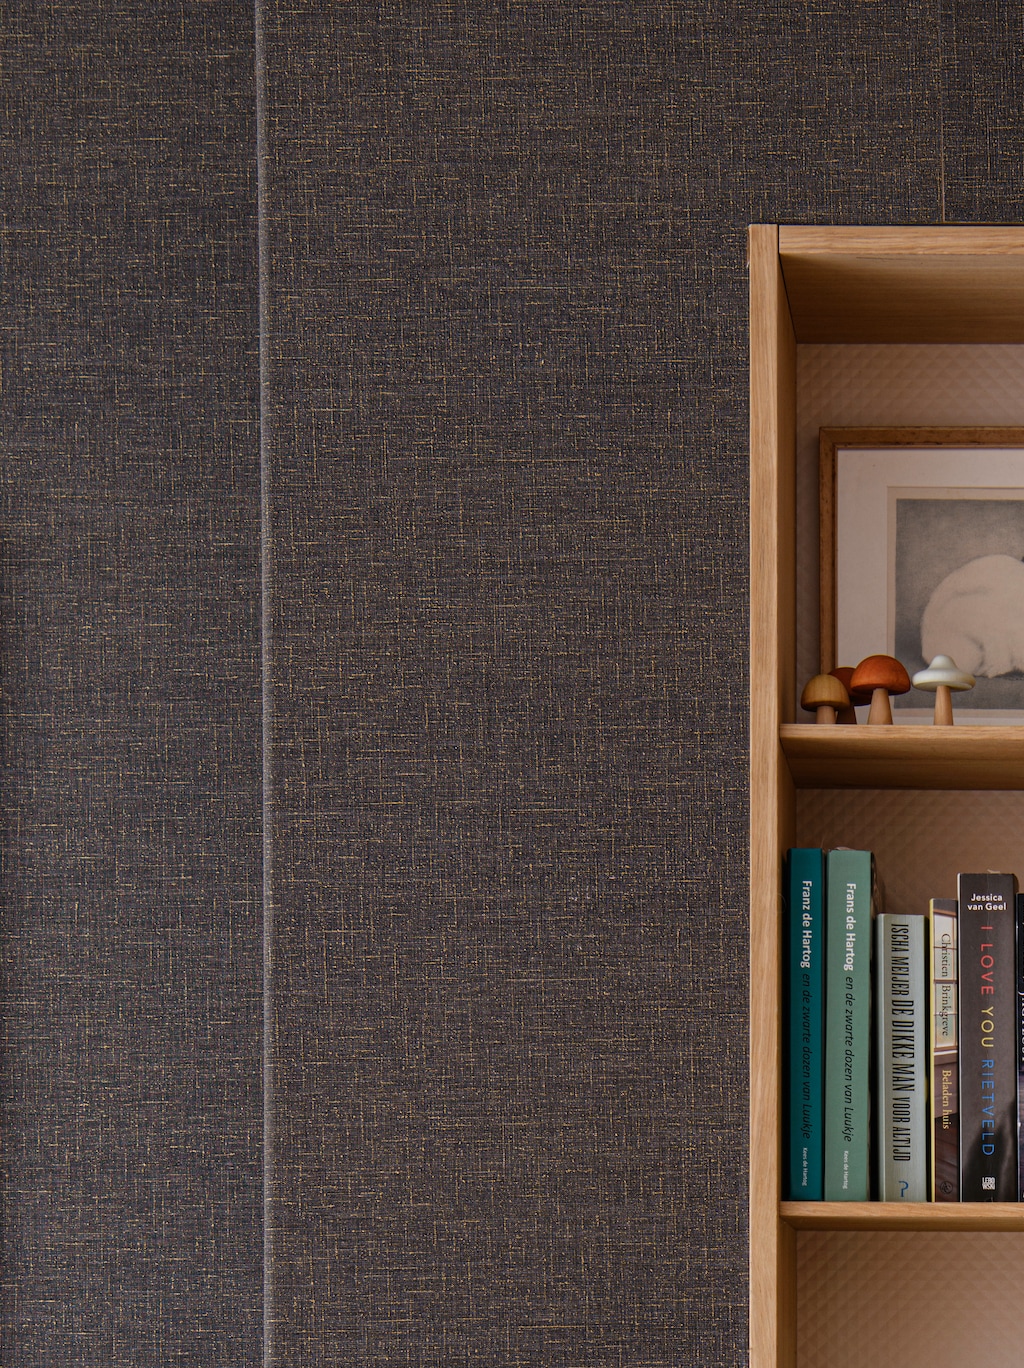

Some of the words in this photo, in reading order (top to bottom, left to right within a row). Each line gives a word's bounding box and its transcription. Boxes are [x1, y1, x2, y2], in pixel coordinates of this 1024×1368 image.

[802, 880, 812, 910] Franz
[846, 883, 856, 913] Frans
[971, 893, 1003, 902] Jessica
[985, 902, 1007, 911] Geel
[802, 913, 813, 927] de
[846, 916, 856, 930] de
[800, 930, 812, 968] Hartog
[843, 933, 856, 971] Hartog
[891, 923, 909, 952] ISCHA
[941, 933, 951, 977] Christien
[981, 943, 995, 995] LOVE
[802, 974, 811, 987] en
[845, 976, 854, 990] en
[891, 956, 909, 995] MEIJER
[802, 990, 812, 1003] de
[845, 993, 855, 1007] de
[892, 1000, 914, 1016] DE
[939, 985, 952, 1036] Brinkgreve
[802, 1006, 812, 1043] zwarte
[845, 1010, 854, 1047] zwarte
[892, 1020, 915, 1058] DIKKE
[981, 1006, 995, 1047] YOU
[802, 1047, 812, 1078] dozen
[844, 1050, 855, 1081] dozen
[892, 1063, 915, 1091] MAN
[802, 1081, 811, 1101] van
[844, 1084, 853, 1104] van
[942, 1070, 952, 1107] Beladen
[800, 1104, 813, 1140] Luukje
[892, 1097, 911, 1123] VOOR
[943, 1109, 952, 1130] huis
[981, 1059, 995, 1155] RIETVELD
[842, 1107, 855, 1142] Luukje
[893, 1126, 911, 1161] ALTIJD
